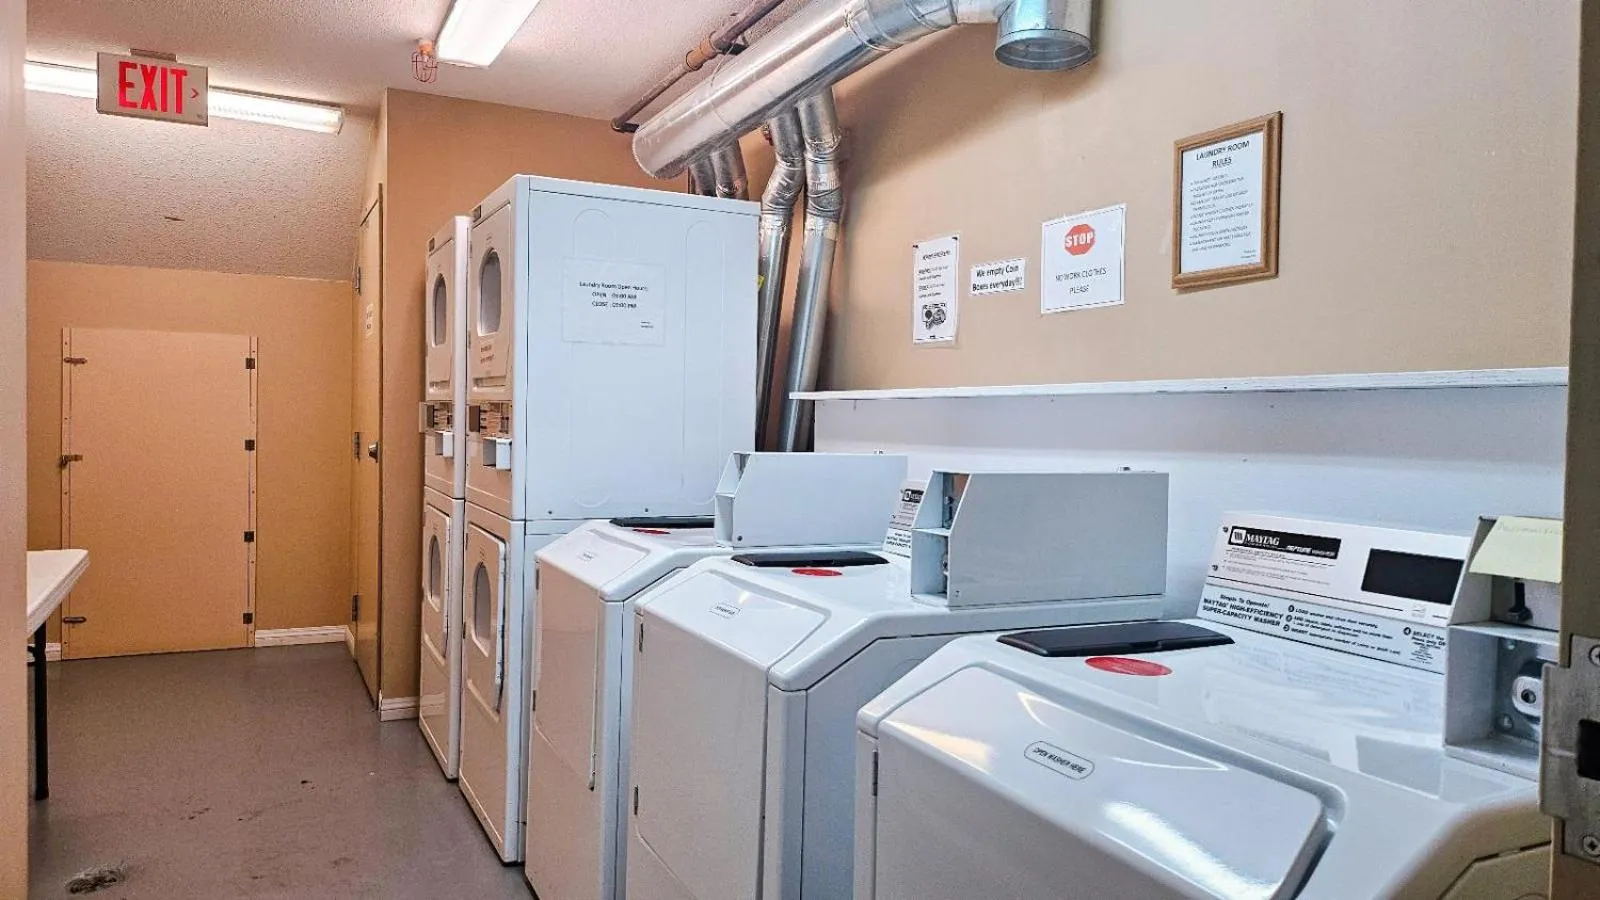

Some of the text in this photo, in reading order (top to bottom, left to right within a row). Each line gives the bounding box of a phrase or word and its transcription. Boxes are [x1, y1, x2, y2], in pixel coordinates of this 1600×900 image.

[118, 62, 188, 114] EXIT
[1196, 140, 1250, 160] LAUNDRY ROOM
[1212, 156, 1232, 167] RULES
[1065, 231, 1094, 248] STOP
[976, 264, 1020, 278] We empty Coin
[1064, 272, 1081, 280] WORK
[1082, 267, 1107, 278] CLOTHES
[580, 281, 600, 289] Laundry
[972, 282, 989, 292] Boxes
[1070, 284, 1089, 294] PLEASE
[1246, 533, 1280, 546] MAYTAG
[1202, 605, 1281, 627] SUPER-CAPACITY WASHER
[1230, 604, 1284, 620] HIGH-EFFICIENCY
[1047, 754, 1071, 766] WASHER
